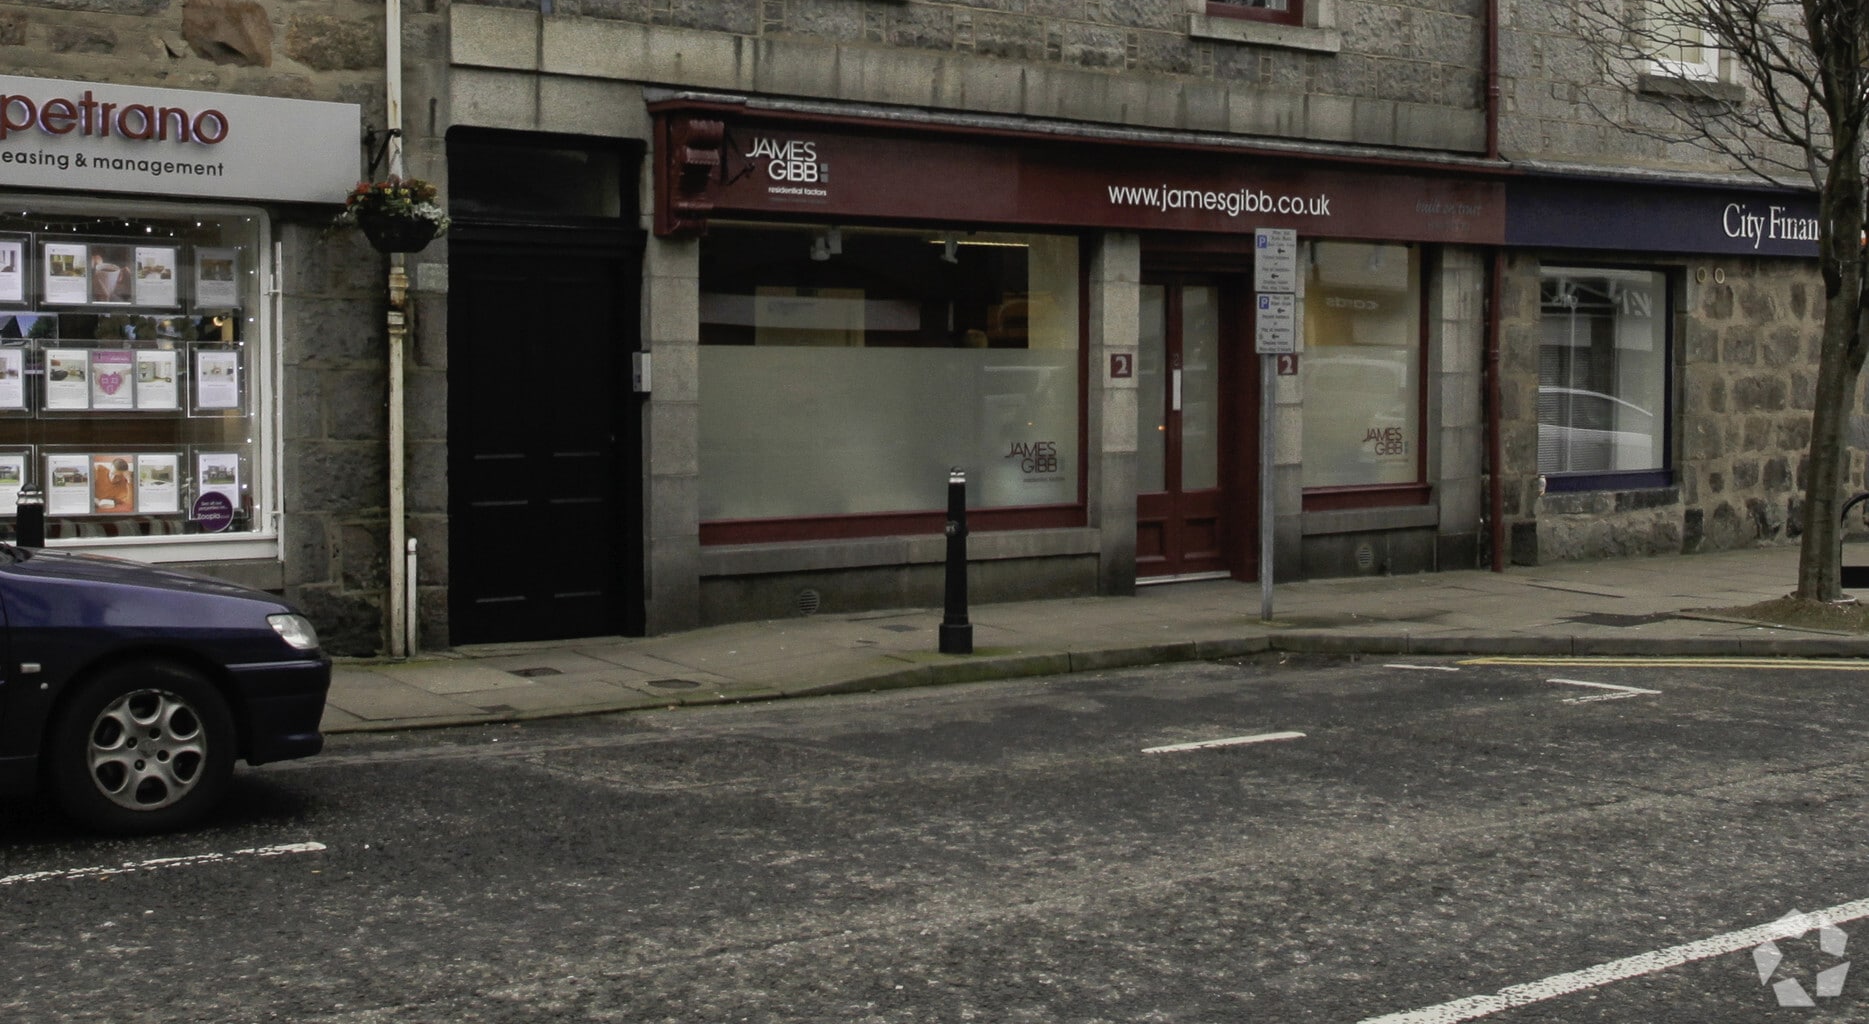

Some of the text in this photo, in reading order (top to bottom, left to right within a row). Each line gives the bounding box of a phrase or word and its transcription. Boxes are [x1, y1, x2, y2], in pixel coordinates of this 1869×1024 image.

[745, 137, 817, 162] JAMES
[76, 153, 88, 167] &
[93, 155, 224, 176] management
[768, 159, 818, 182] GIBB
[768, 186, 827, 196] residential factors
[1108, 184, 1330, 217] www.jamesgibb.co.uk
[1723, 202, 1821, 249] City Finan
[1115, 355, 1128, 374] 2
[1281, 355, 1293, 374] 2
[1362, 427, 1402, 442] JAMES
[1004, 441, 1057, 458] JAMES
[1021, 457, 1057, 474] GIBB
